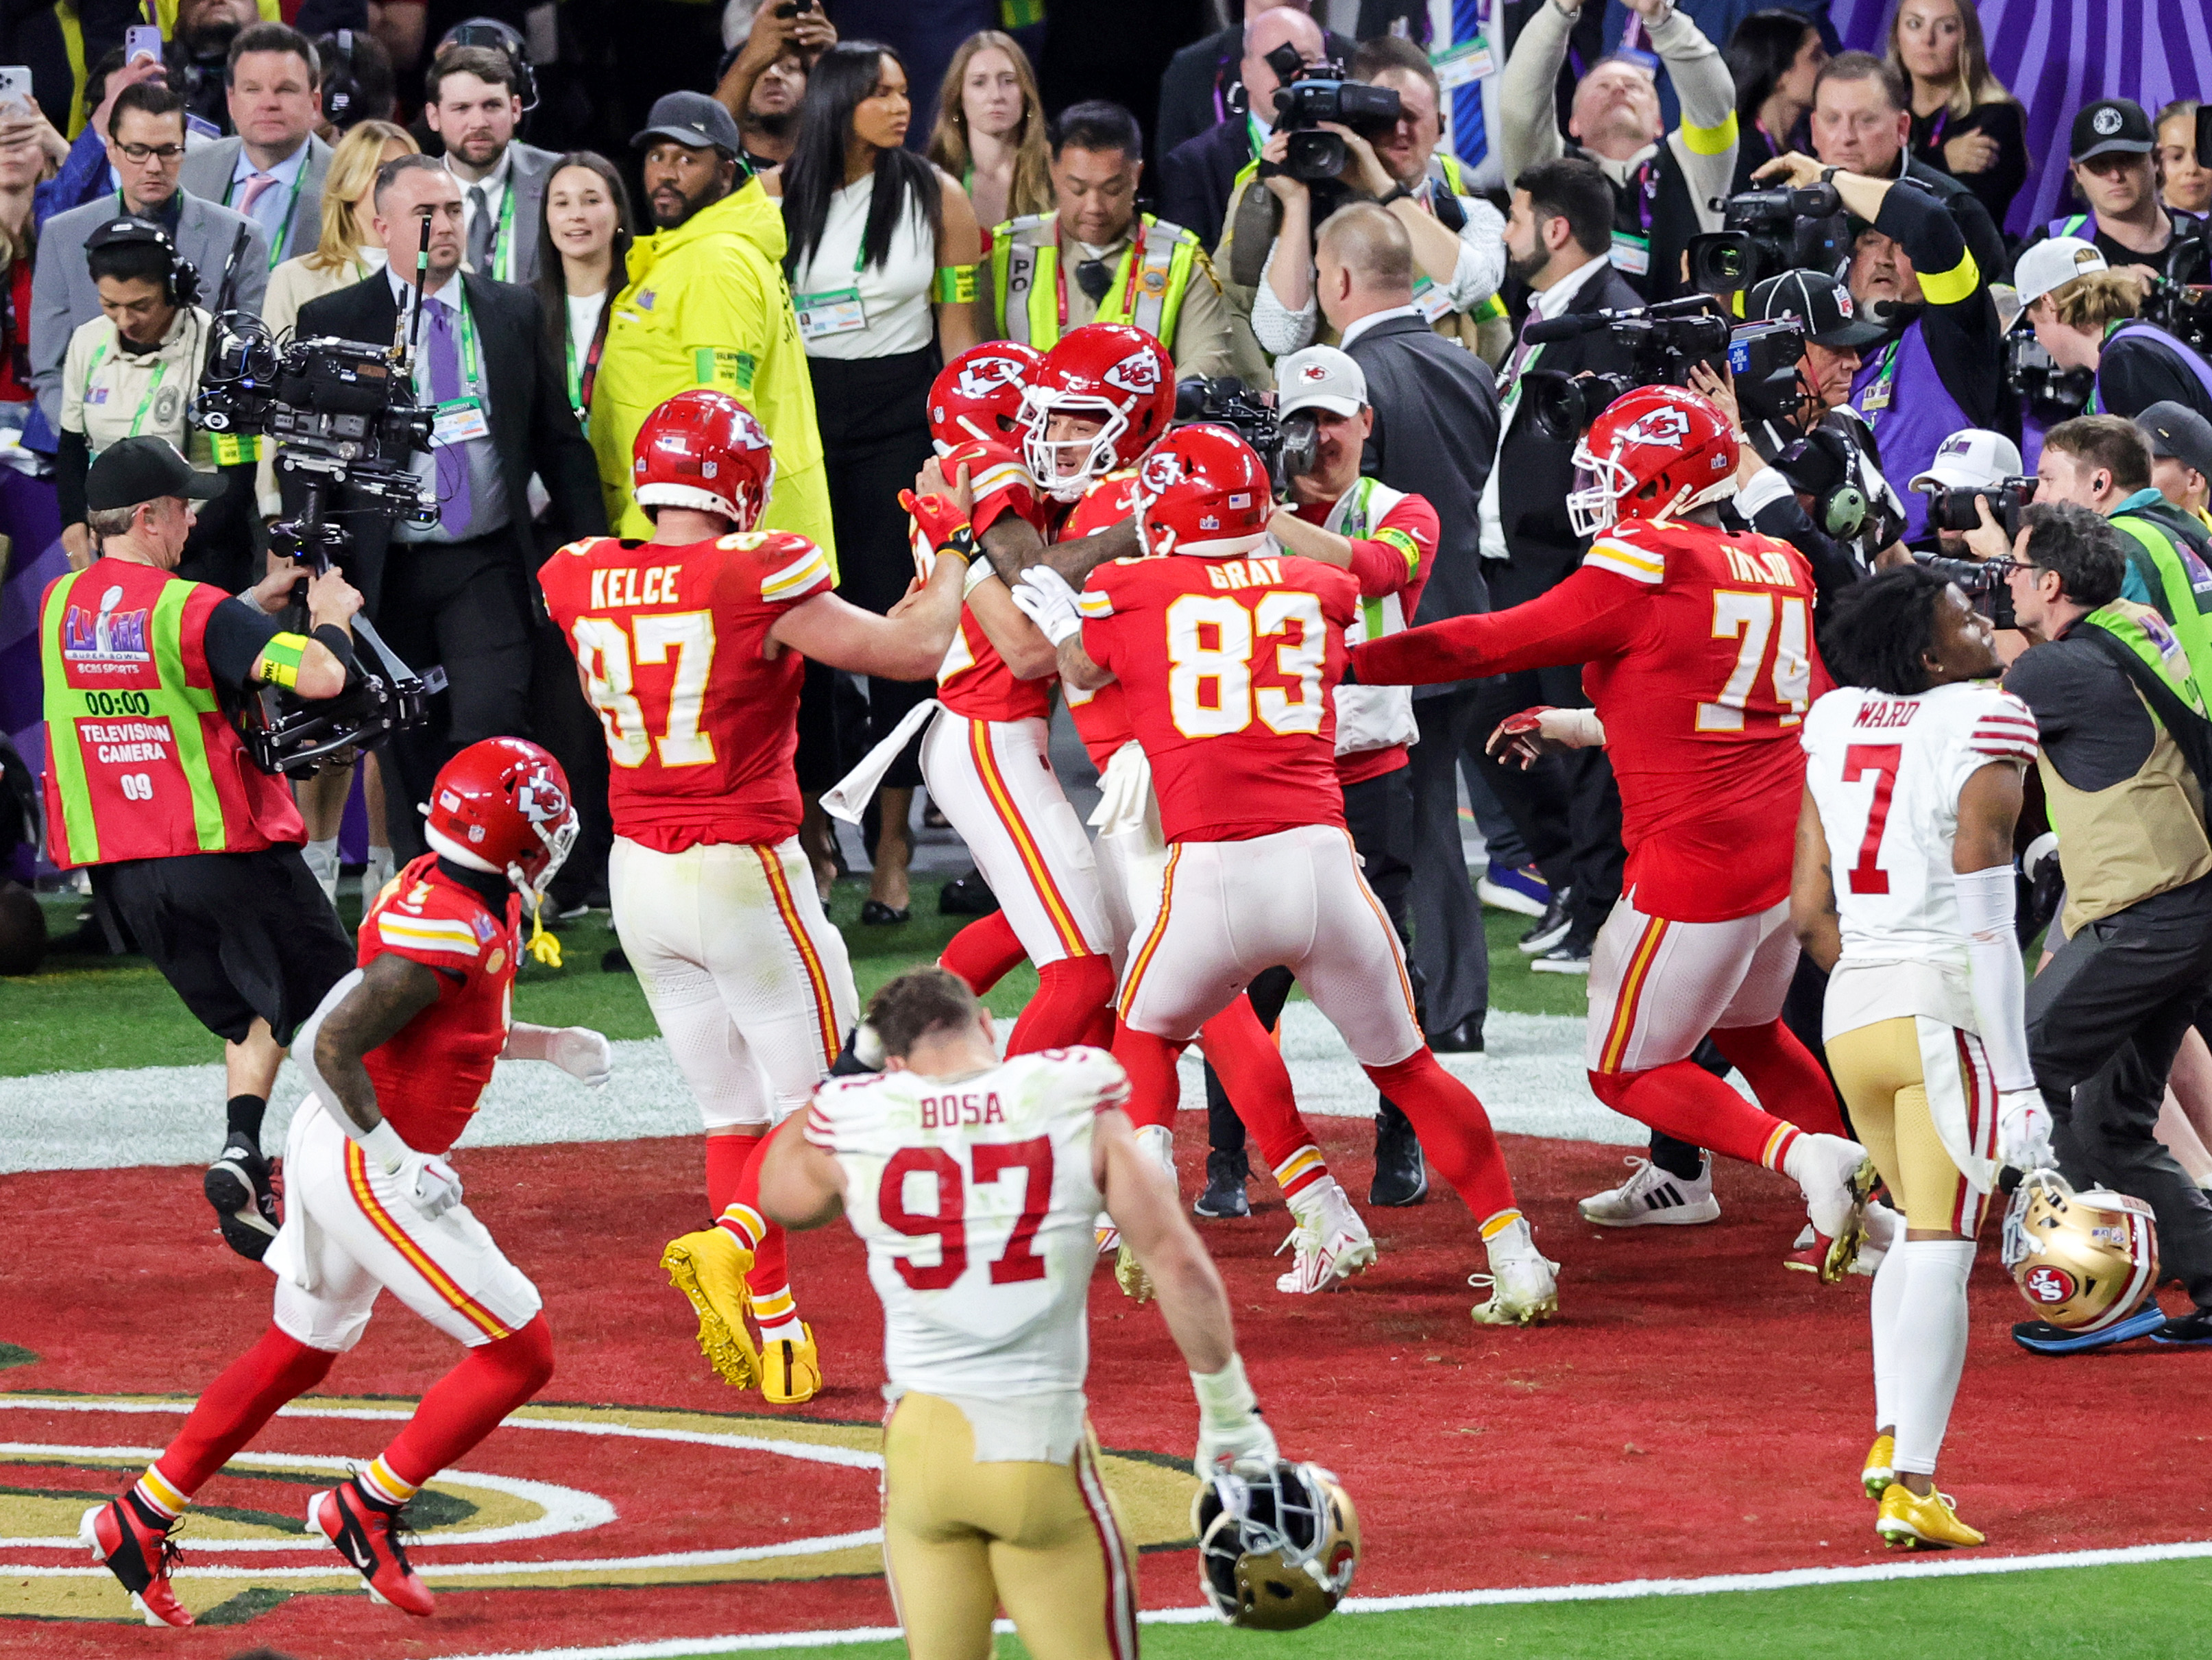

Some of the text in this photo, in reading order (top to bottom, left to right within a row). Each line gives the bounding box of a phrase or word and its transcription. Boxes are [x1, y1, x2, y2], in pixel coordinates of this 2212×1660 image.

[590, 564, 683, 610] KELCE
[1205, 559, 1285, 590] GRAY
[103, 664, 140, 675] SPORTS
[1165, 590, 1328, 739] 83
[1695, 588, 1811, 732] 74
[85, 690, 150, 716] 00:00
[572, 608, 718, 769] 87
[1853, 701, 1921, 728] WARD
[80, 723, 171, 743] TELEVISION
[98, 743, 167, 764] CAMERA
[120, 773, 154, 801] 09
[1841, 743, 1903, 895] 7
[921, 1092, 1005, 1129] BOSA
[879, 1133, 1054, 1290] 97
